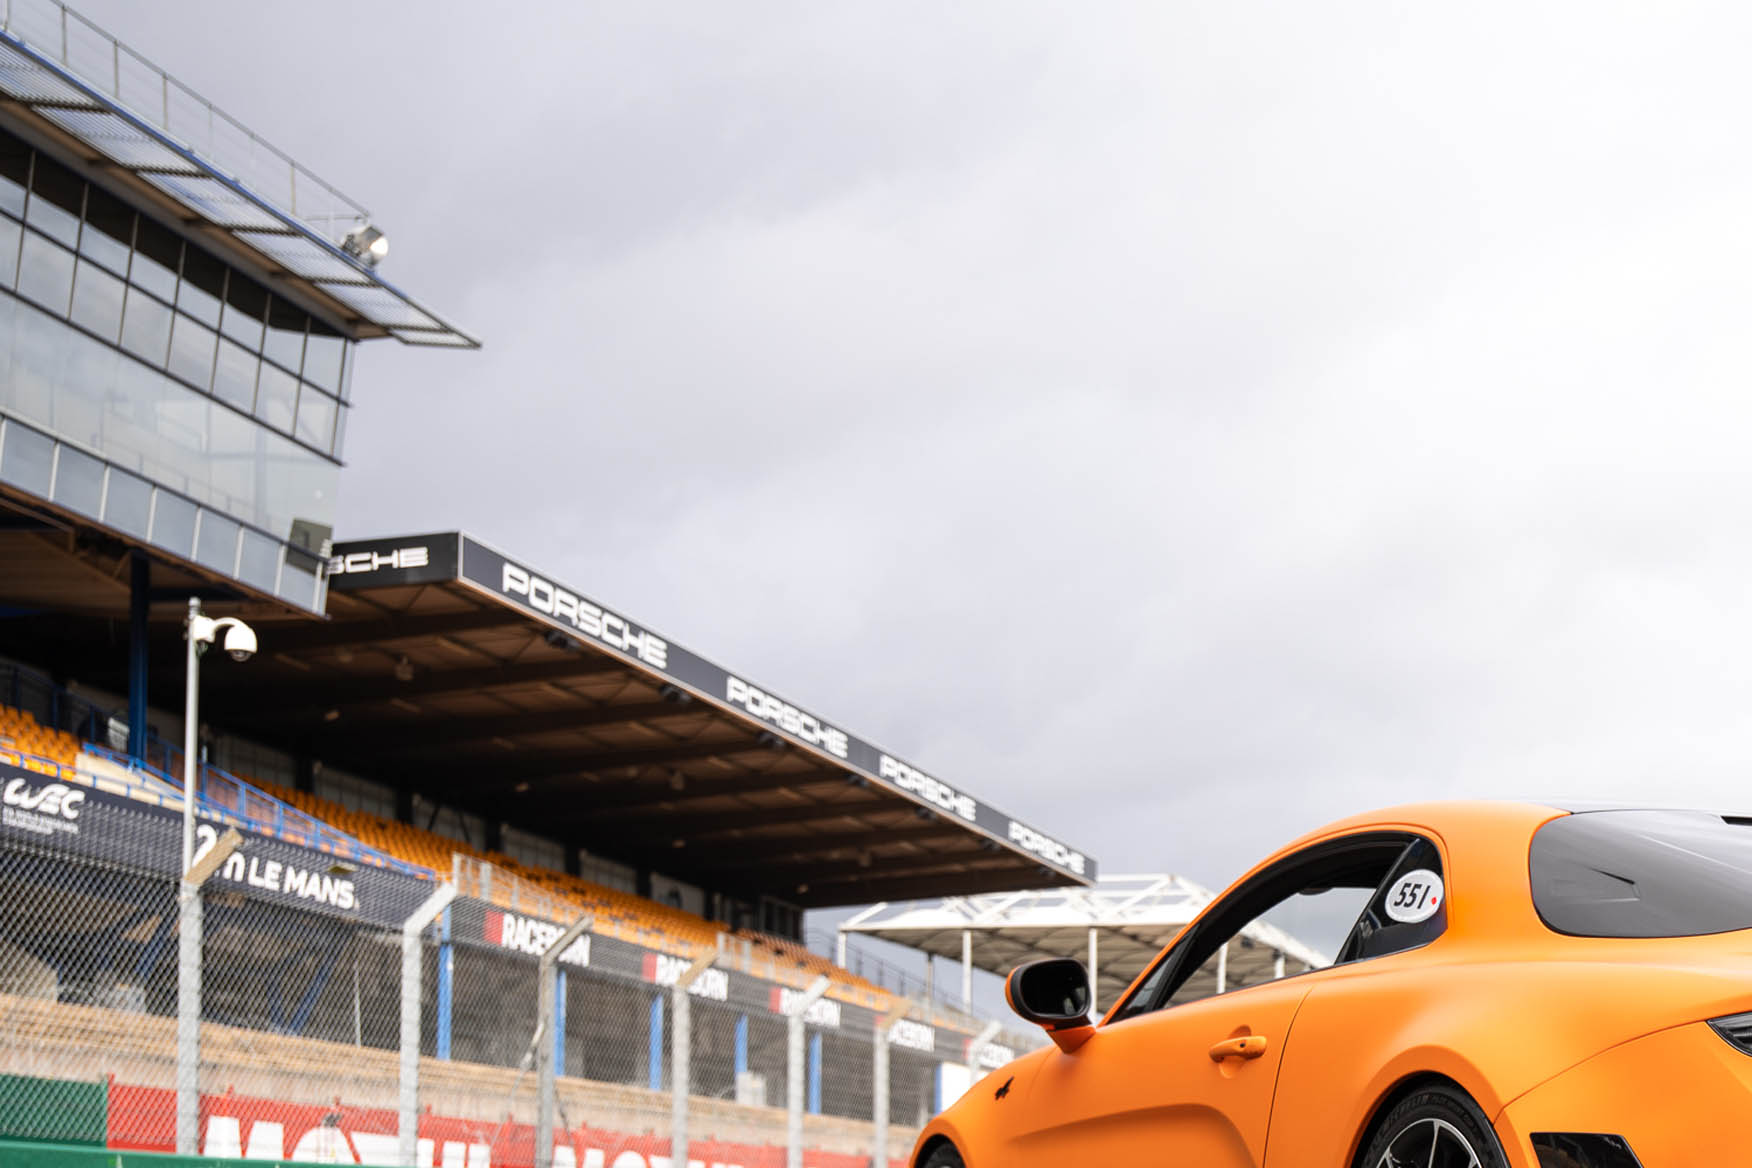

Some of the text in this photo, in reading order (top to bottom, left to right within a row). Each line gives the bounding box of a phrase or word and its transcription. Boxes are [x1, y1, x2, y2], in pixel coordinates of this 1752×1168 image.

[503, 562, 667, 669] PORSCHE
[727, 675, 848, 758] PORSCHE
[880, 754, 976, 821] PORSCHE
[1008, 820, 1085, 875] PORSCHE
[248, 857, 282, 891] LE
[283, 866, 355, 909] MANS
[1394, 883, 1430, 909] 551
